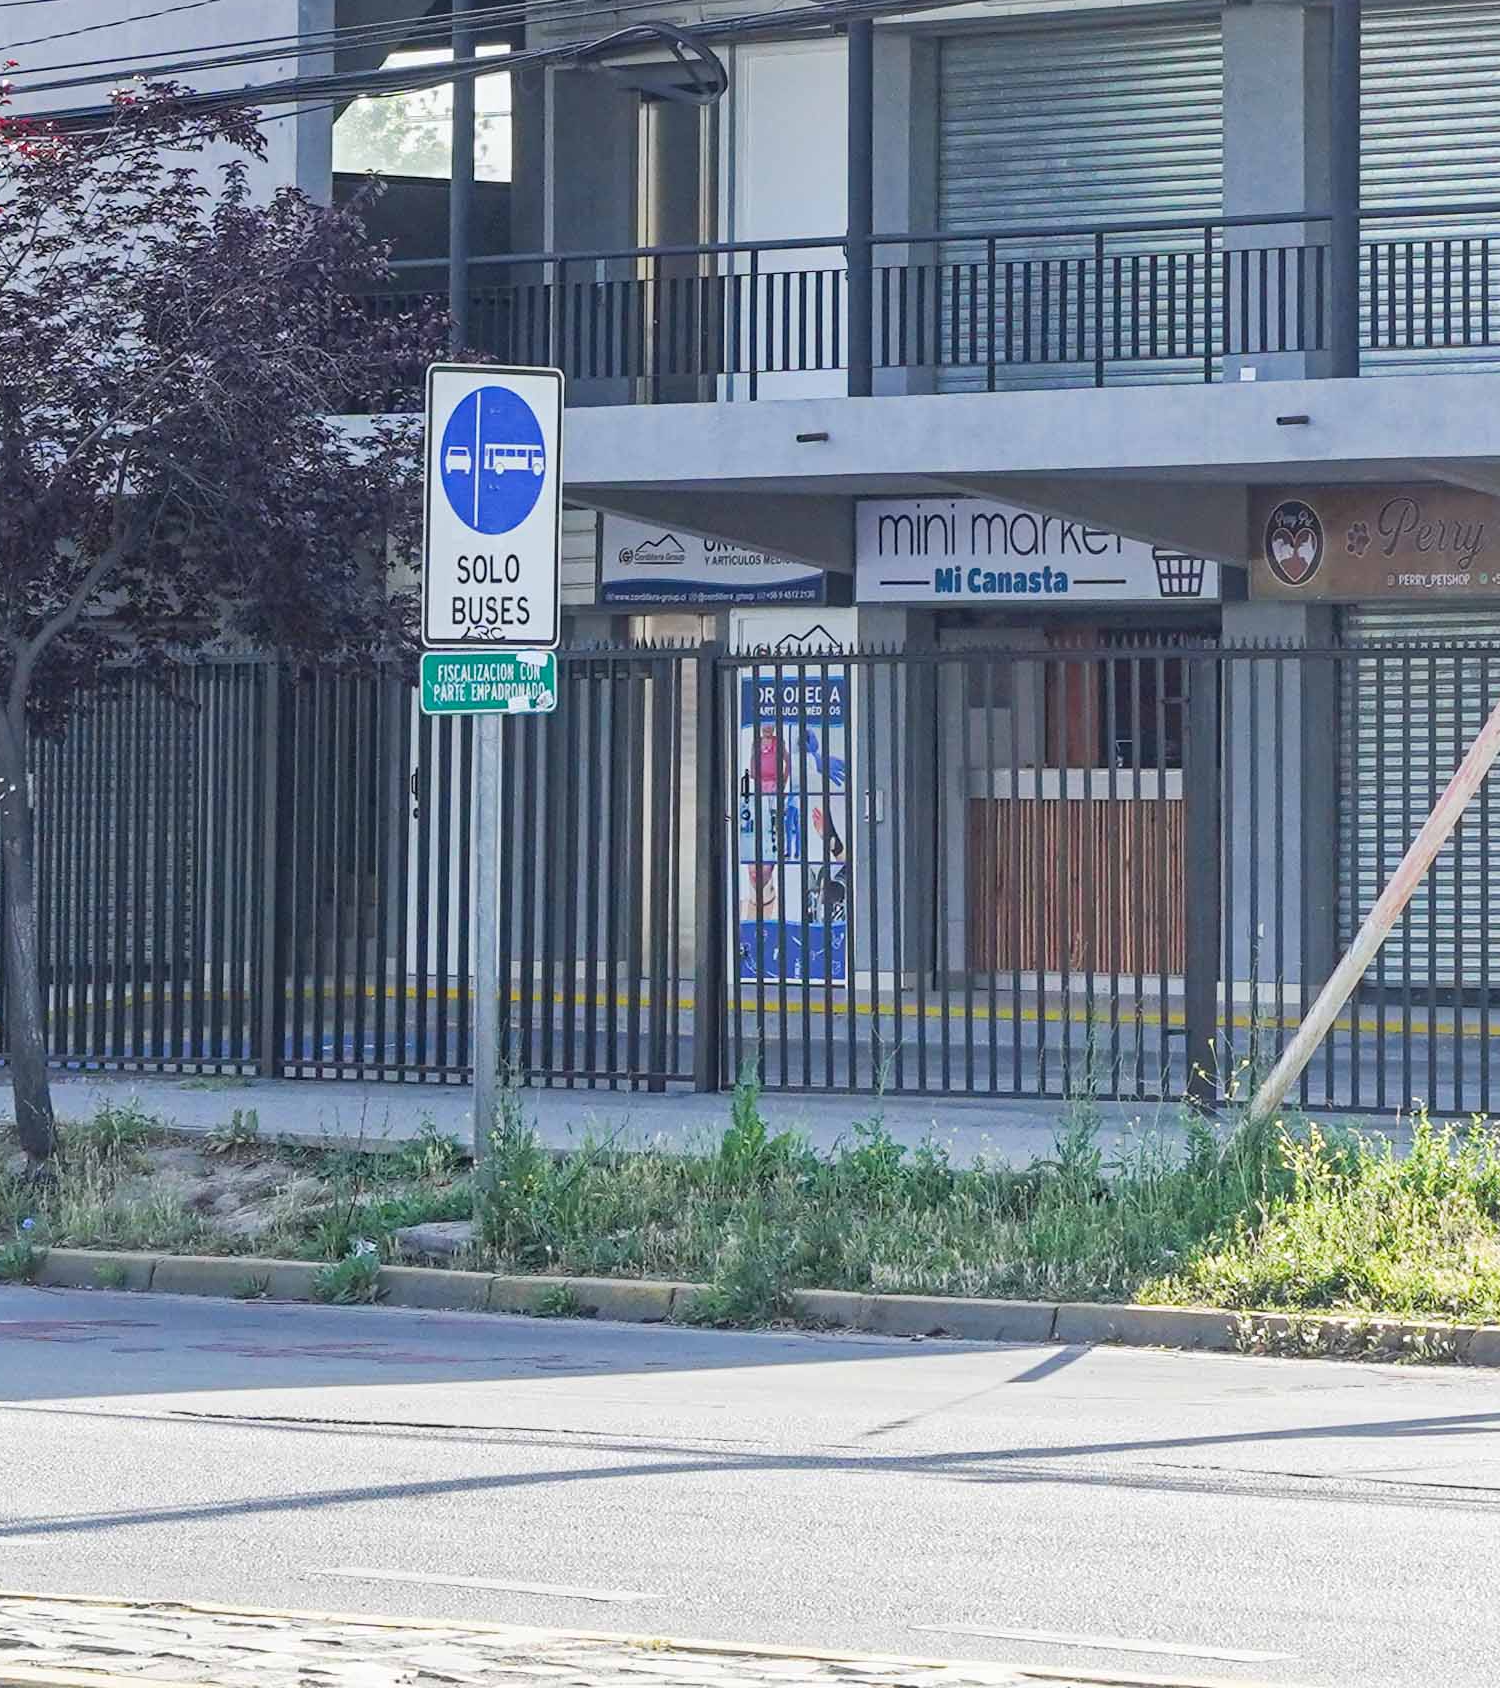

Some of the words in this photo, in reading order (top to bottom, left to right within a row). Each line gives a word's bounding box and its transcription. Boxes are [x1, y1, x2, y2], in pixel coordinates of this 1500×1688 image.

[878, 503, 956, 556] mini
[1377, 495, 1486, 569] Perry
[457, 554, 520, 584] SOLO
[934, 566, 962, 594] Mi
[967, 566, 1069, 594] Canasta
[1398, 573, 1471, 587] PERRY_PETSHOP
[452, 596, 530, 625] BUSES
[438, 663, 514, 682] FISCALIZACION
[520, 662, 541, 681] CON
[433, 683, 467, 702] PARTE
[471, 682, 545, 702] EMPADRONADO
